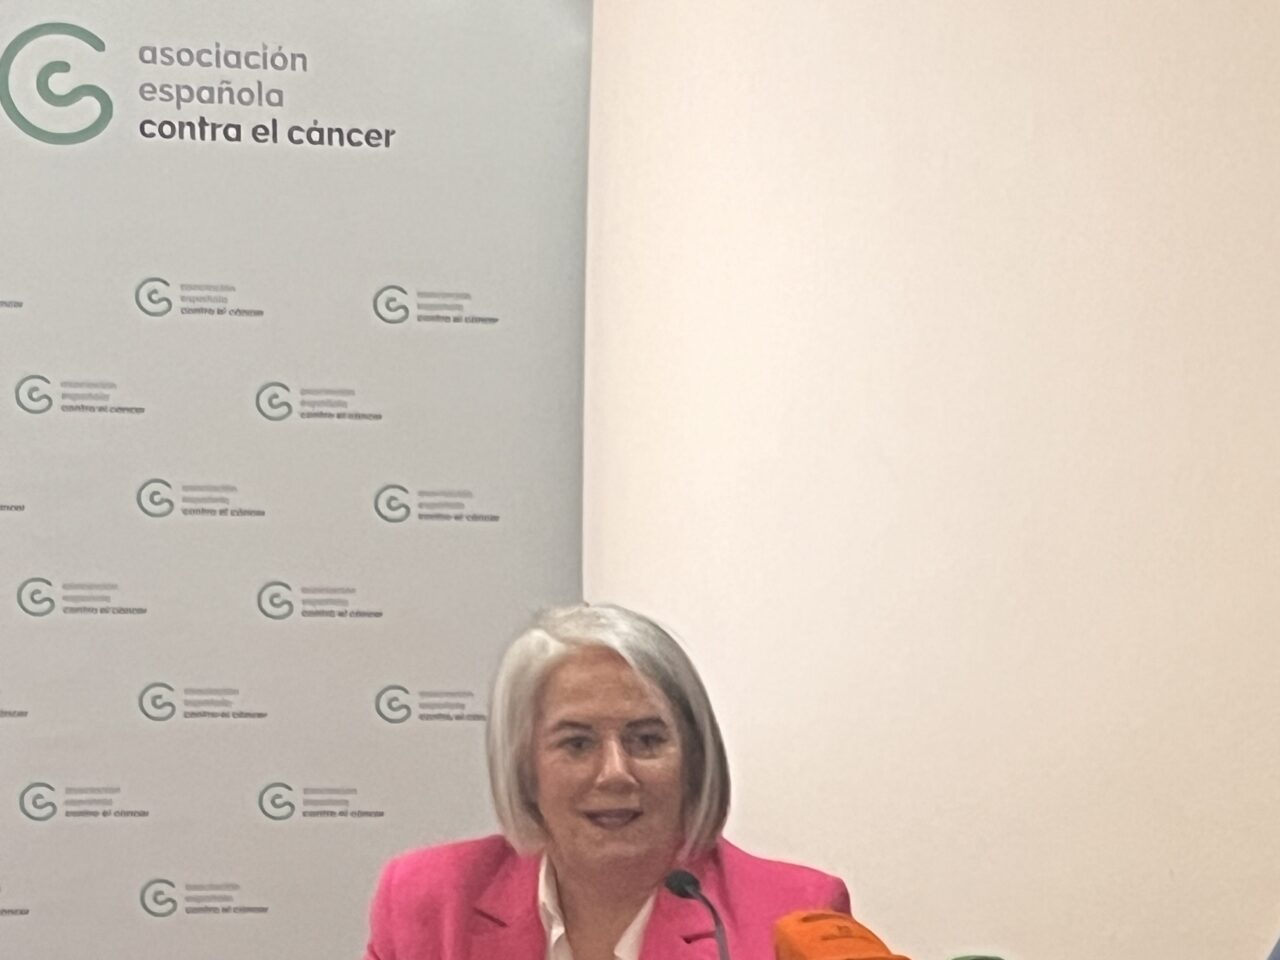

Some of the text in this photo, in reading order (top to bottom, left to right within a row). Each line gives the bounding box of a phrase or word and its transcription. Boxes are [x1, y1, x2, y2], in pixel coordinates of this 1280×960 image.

[138, 41, 308, 73] asociación
[138, 79, 284, 111] española
[138, 115, 397, 149] contra el cáncer
